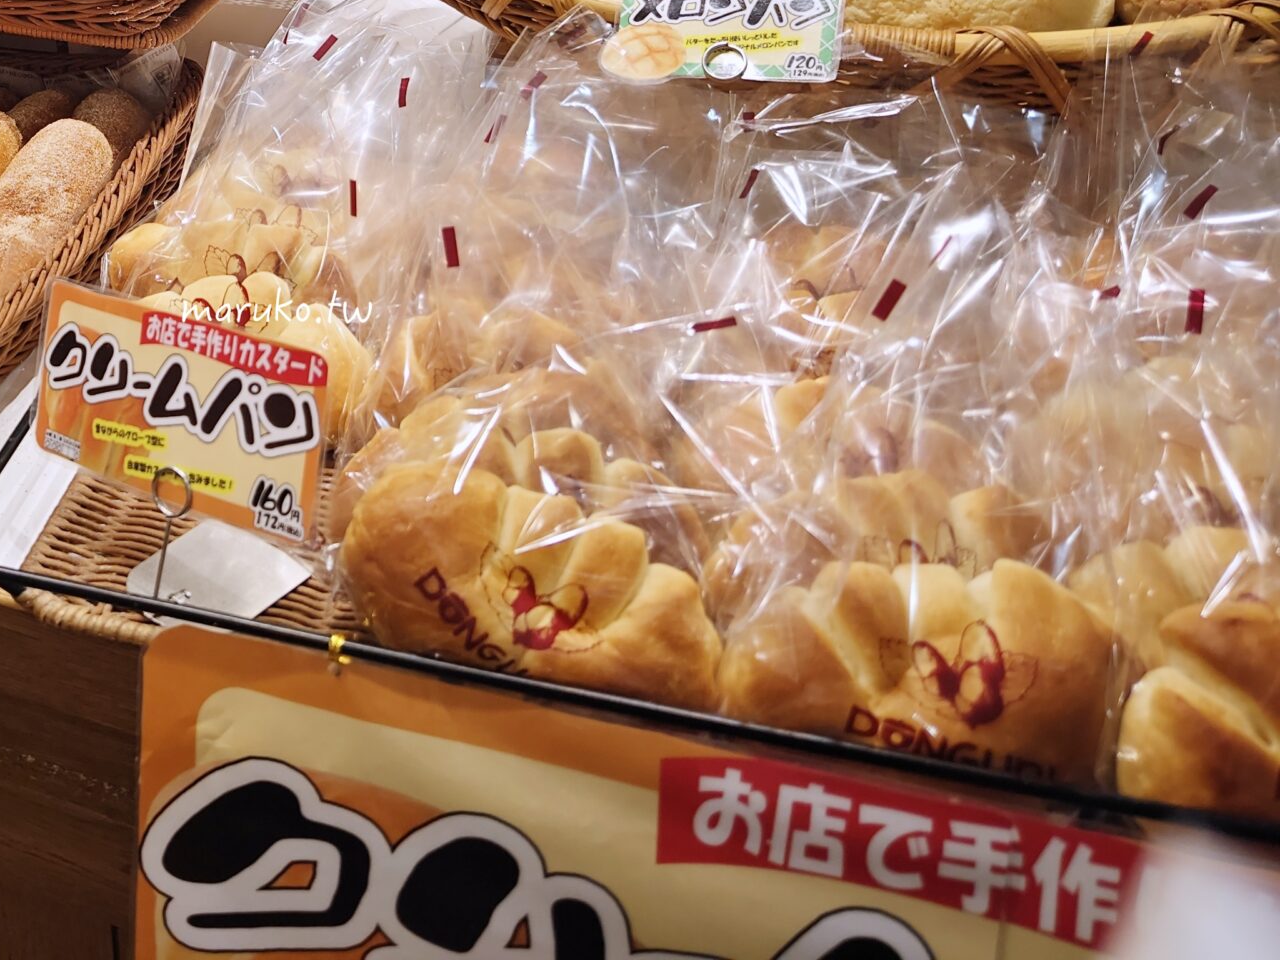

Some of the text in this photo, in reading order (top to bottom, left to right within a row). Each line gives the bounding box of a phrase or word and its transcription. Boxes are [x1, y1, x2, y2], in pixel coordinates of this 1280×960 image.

[50, 329, 313, 449] クリームパン
[146, 315, 323, 382] お店で手作りカスタード
[252, 480, 299, 522] 160円
[693, 767, 1150, 943] お店で手作
